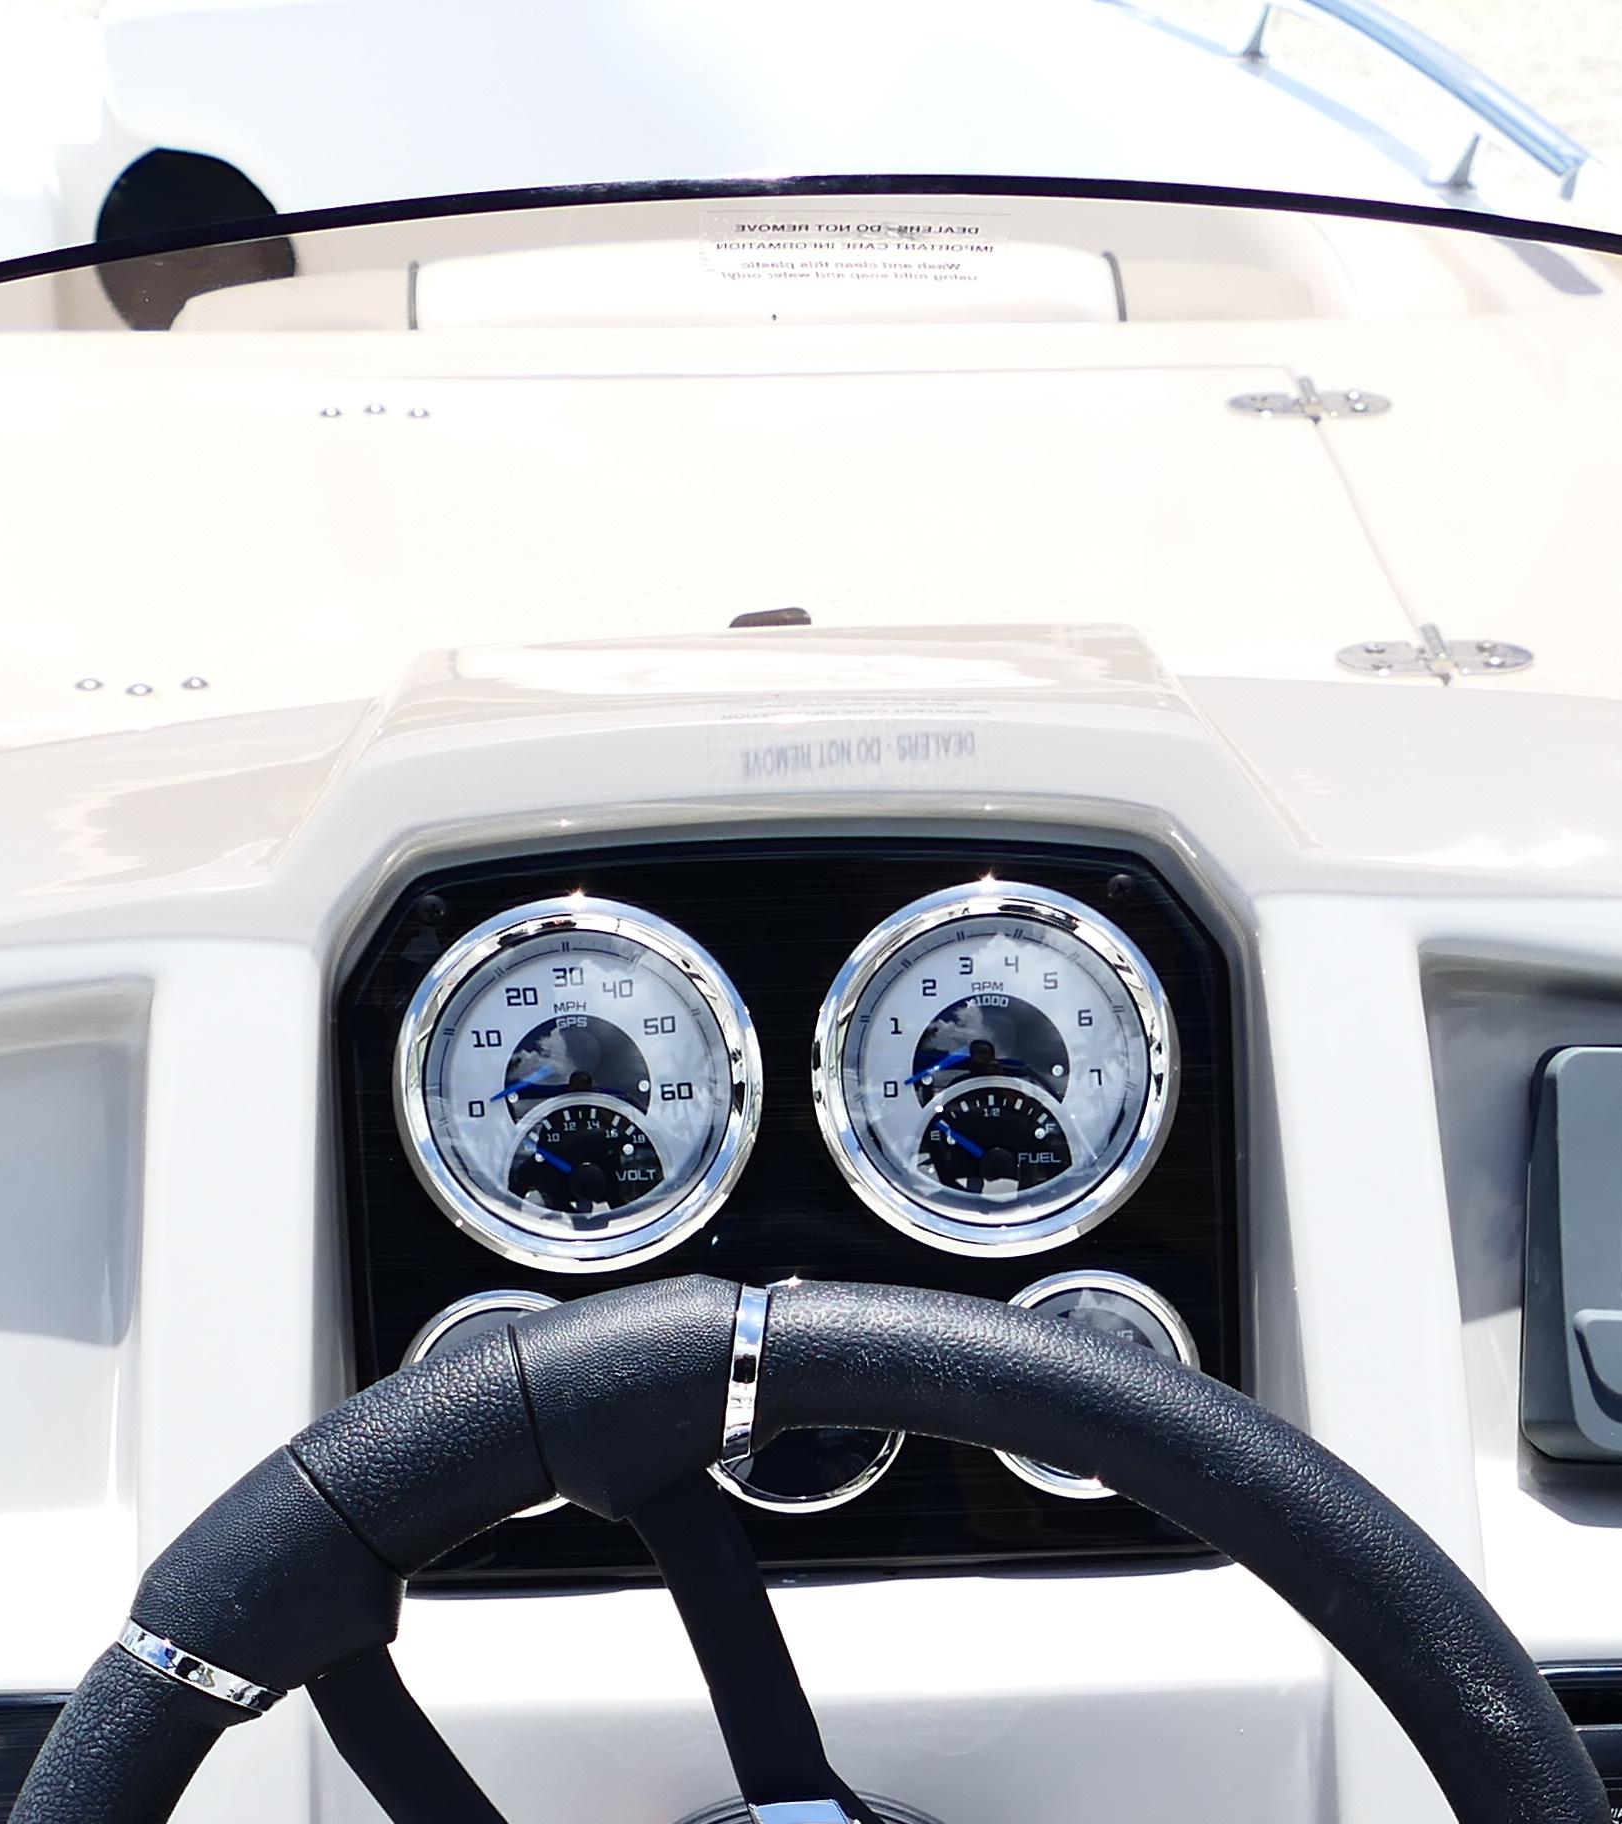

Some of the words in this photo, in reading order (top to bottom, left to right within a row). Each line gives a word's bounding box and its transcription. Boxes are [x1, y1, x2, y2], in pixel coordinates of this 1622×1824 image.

[959, 956, 974, 975] 3
[1004, 956, 1019, 973] 4
[552, 967, 584, 988] 30
[1043, 972, 1058, 990] 5
[602, 980, 634, 999] 40
[922, 979, 937, 997] 2
[971, 981, 1004, 993] RPM
[505, 988, 538, 1007] 20
[553, 1001, 587, 1013] MPH
[555, 1016, 588, 1029] GPS
[643, 1016, 676, 1036] 50
[890, 1017, 902, 1035] 1
[1078, 1009, 1093, 1027] 6
[472, 1030, 503, 1048] 10
[1089, 1069, 1104, 1086] 7
[660, 1082, 694, 1101] 60
[883, 1081, 899, 1098] 0
[468, 1100, 486, 1119] 0
[563, 1121, 577, 1132] 12
[587, 1120, 600, 1130] 14
[547, 1133, 560, 1143] 10
[632, 1134, 646, 1144] 18
[930, 1130, 941, 1141] E
[1017, 1152, 1062, 1165] FUEL
[615, 1168, 657, 1183] VOLT
